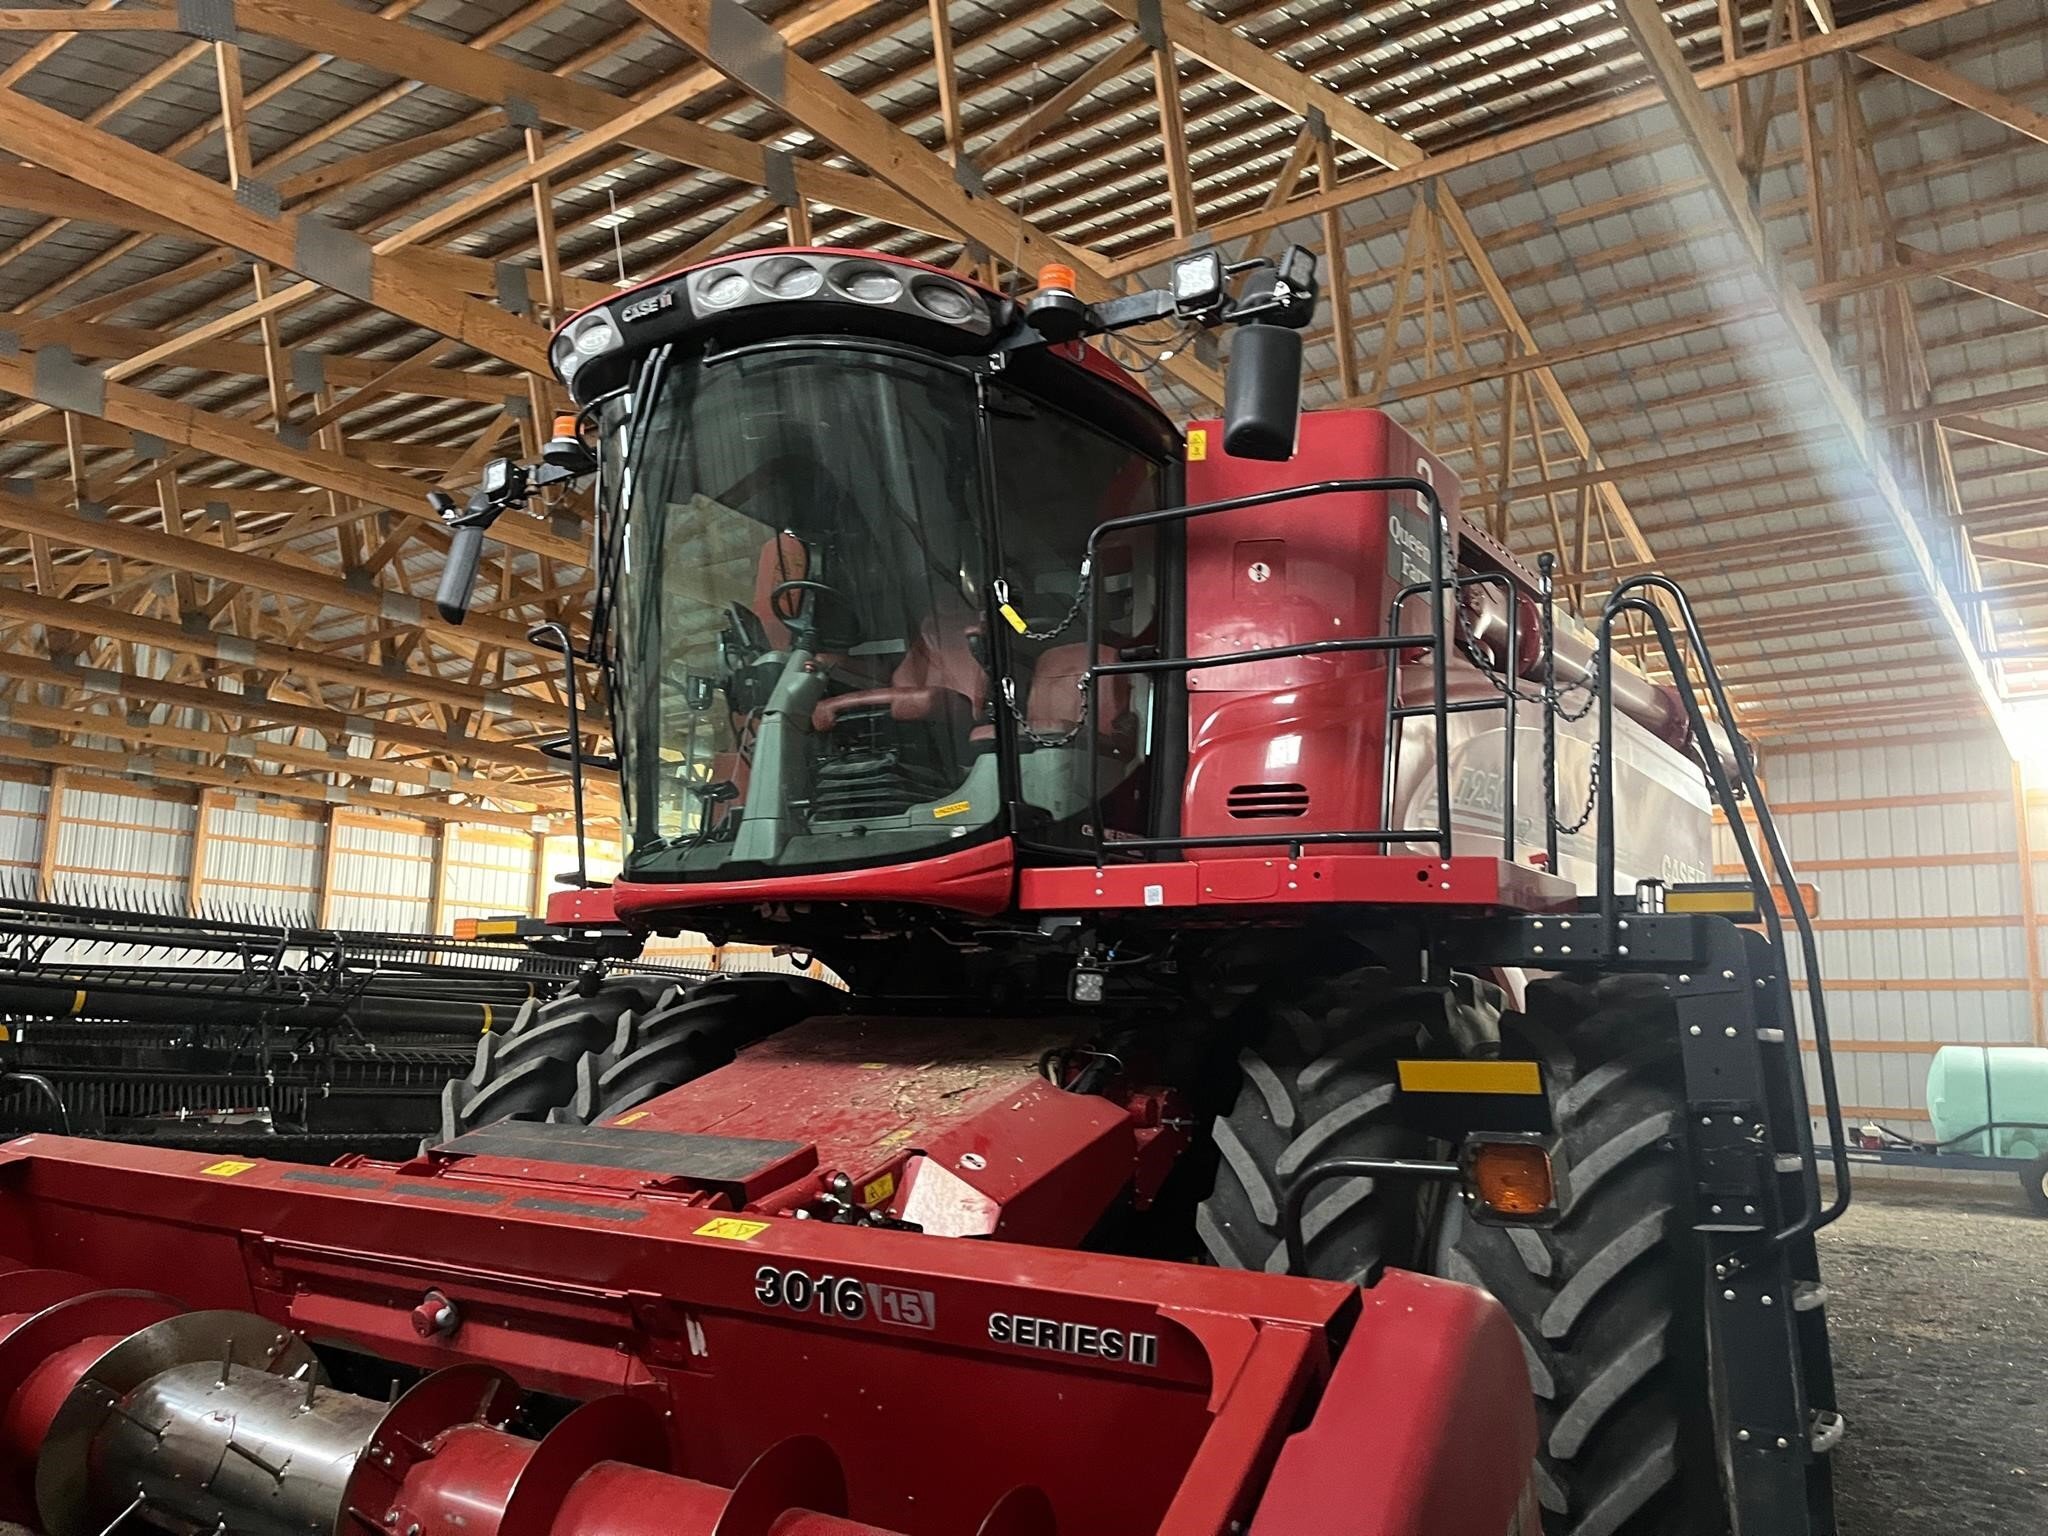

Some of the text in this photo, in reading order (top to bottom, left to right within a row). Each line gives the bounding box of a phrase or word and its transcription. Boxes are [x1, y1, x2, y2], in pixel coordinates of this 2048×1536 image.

[621, 297, 659, 322] CASE
[755, 1265, 923, 1324] 3016 15
[988, 1312, 1158, 1367] SERIES II
